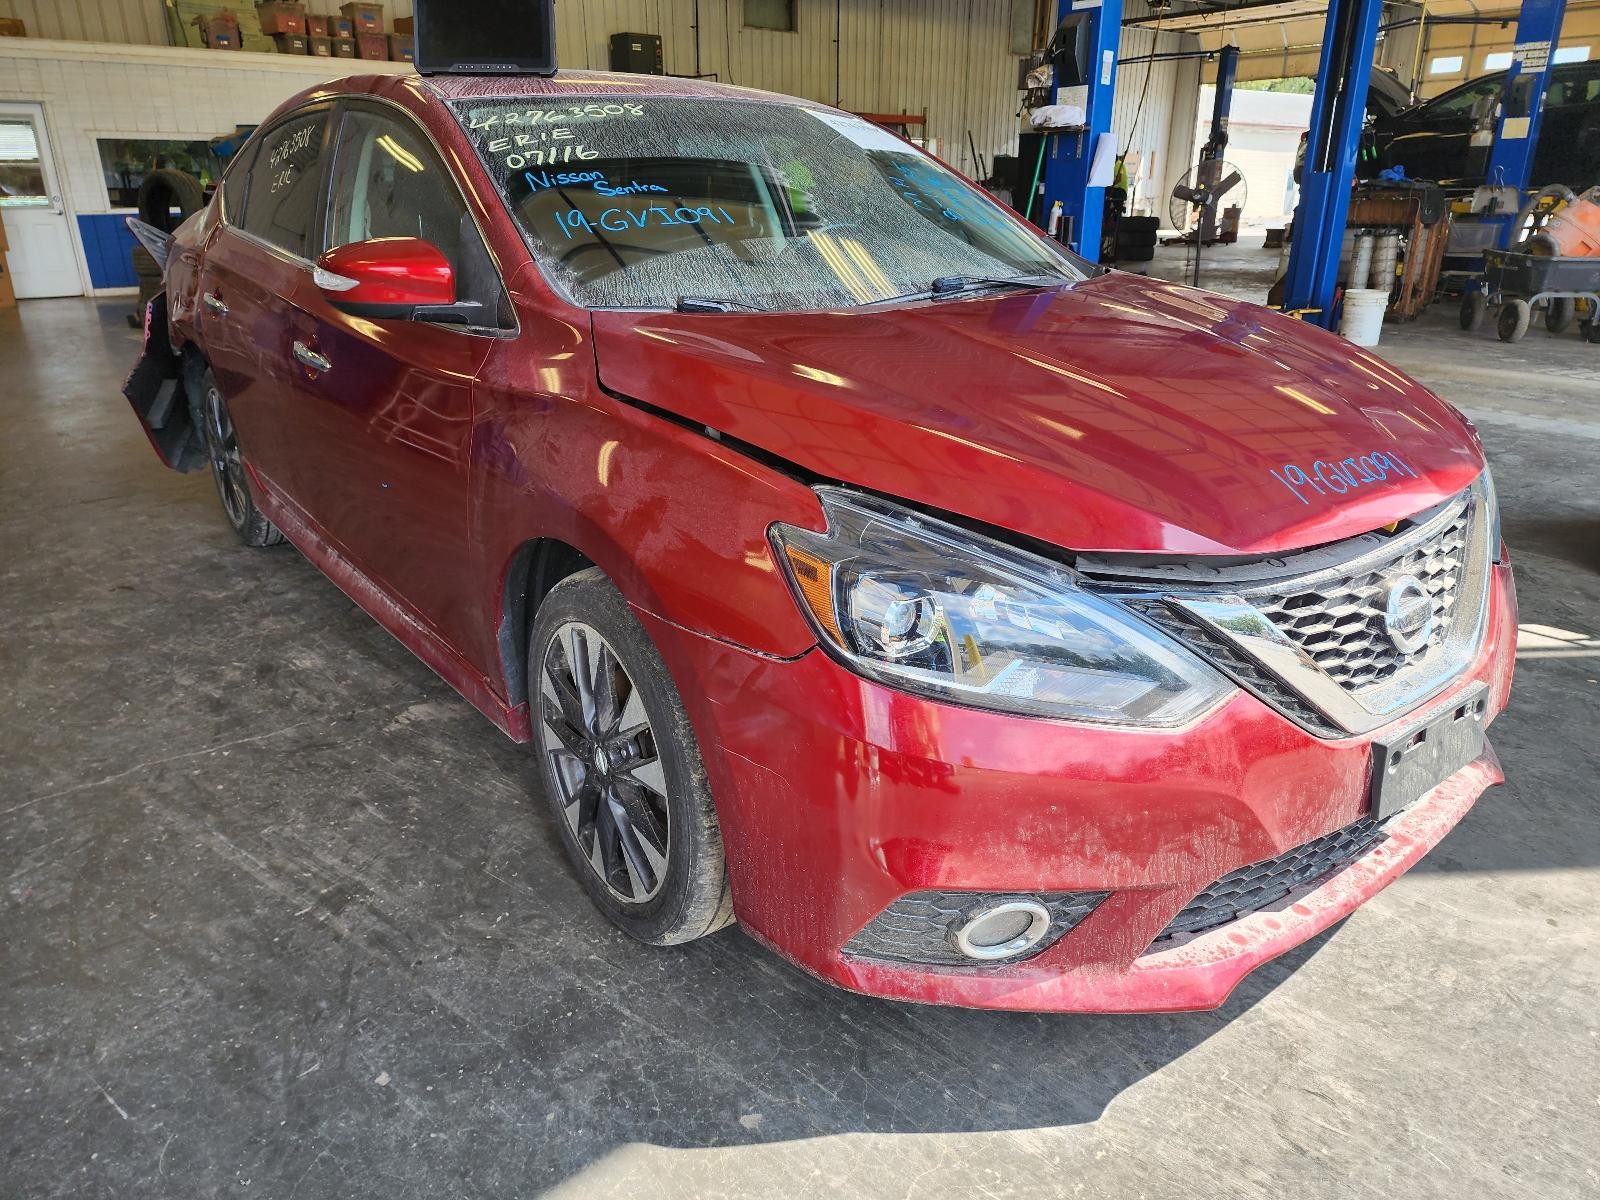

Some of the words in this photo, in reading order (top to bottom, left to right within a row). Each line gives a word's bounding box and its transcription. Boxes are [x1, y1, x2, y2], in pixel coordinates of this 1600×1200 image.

[469, 103, 644, 130] 42763508
[488, 128, 576, 151] ERIE
[525, 170, 605, 192] Nissan
[593, 180, 669, 197] Sentra
